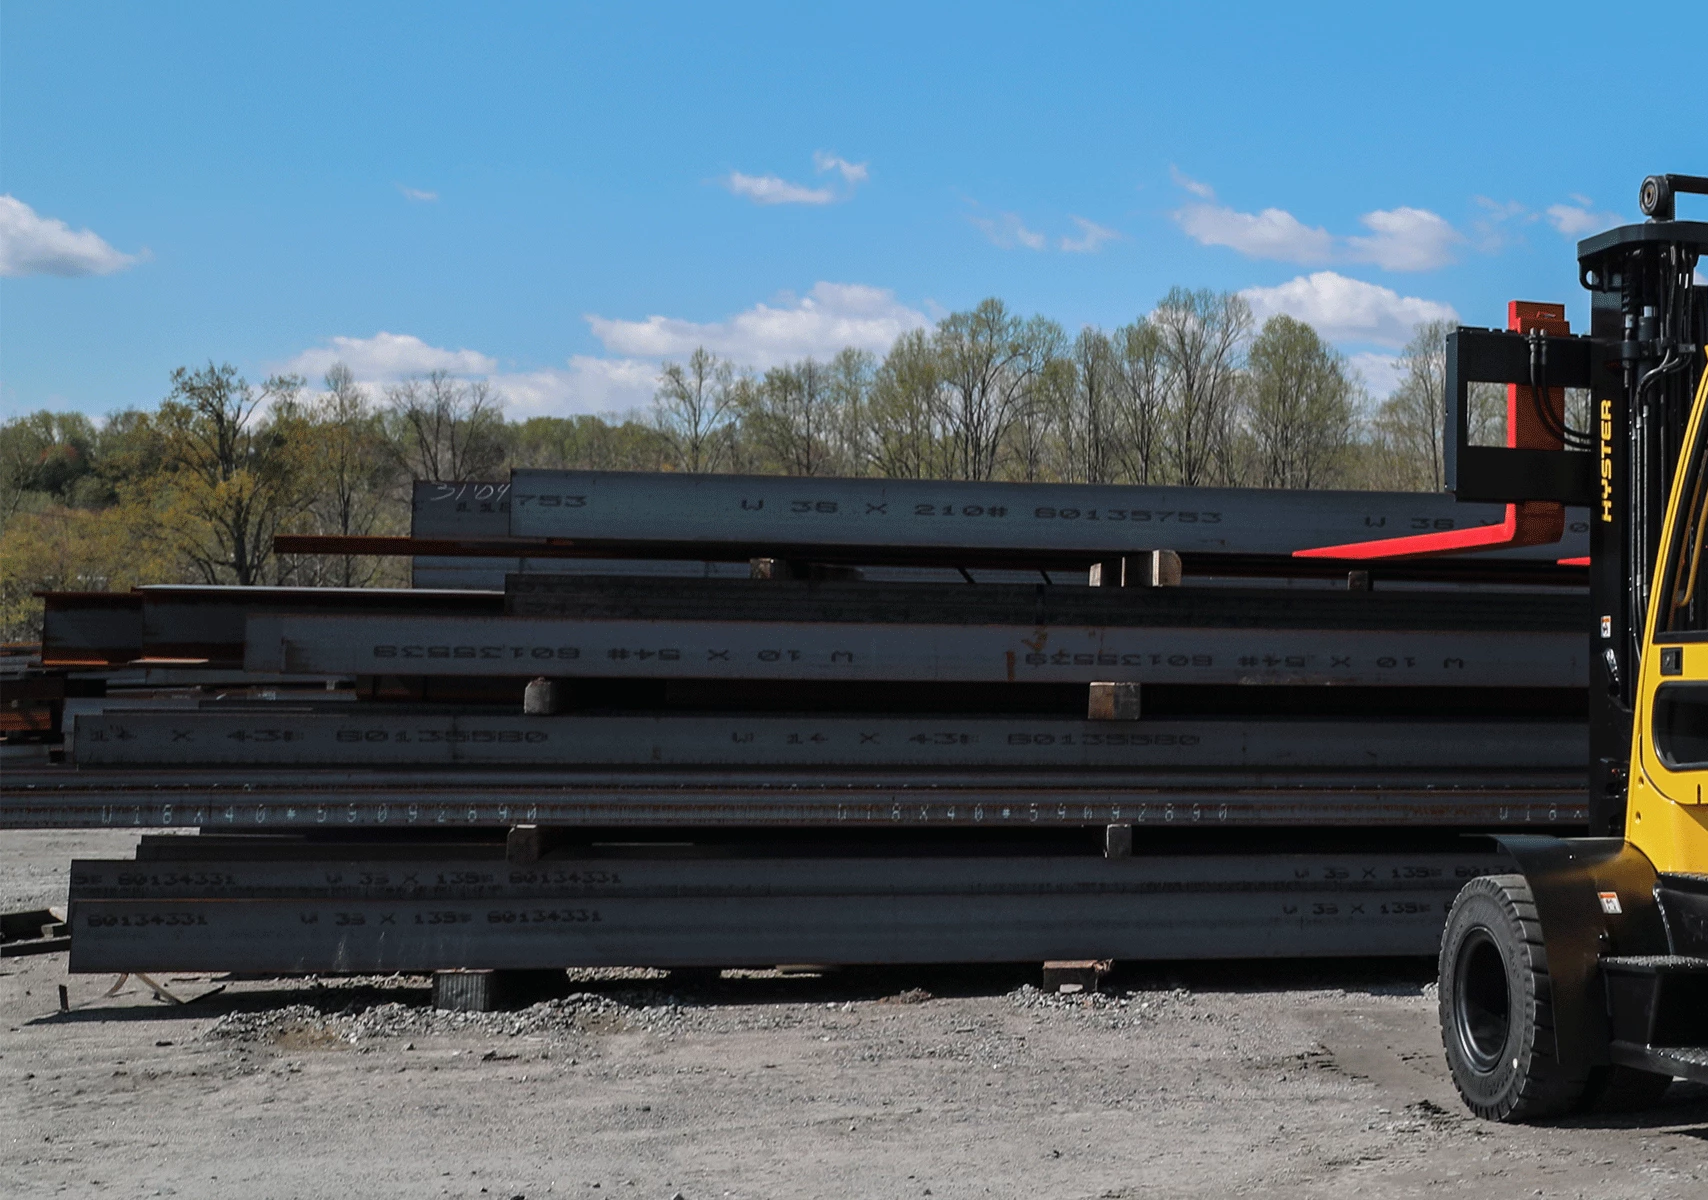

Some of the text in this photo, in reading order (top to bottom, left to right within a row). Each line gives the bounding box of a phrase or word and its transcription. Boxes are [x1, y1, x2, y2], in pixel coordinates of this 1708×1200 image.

[1600, 399, 1613, 523] HYSTER
[741, 499, 764, 511] W
[791, 500, 839, 513] 36
[865, 502, 888, 516] X
[914, 503, 1009, 518] 210#
[1365, 516, 1386, 528] W
[1411, 518, 1454, 529] 36
[706, 650, 729, 663] X
[757, 650, 802, 663] 10
[831, 650, 854, 664] W
[1330, 656, 1352, 669] X
[1376, 657, 1416, 669] 10
[1443, 658, 1466, 670] W
[172, 728, 195, 742] X
[732, 732, 754, 744] W
[859, 732, 880, 745] X
[1362, 866, 1377, 880] X
[1351, 902, 1365, 915] X
[380, 912, 396, 925] X
